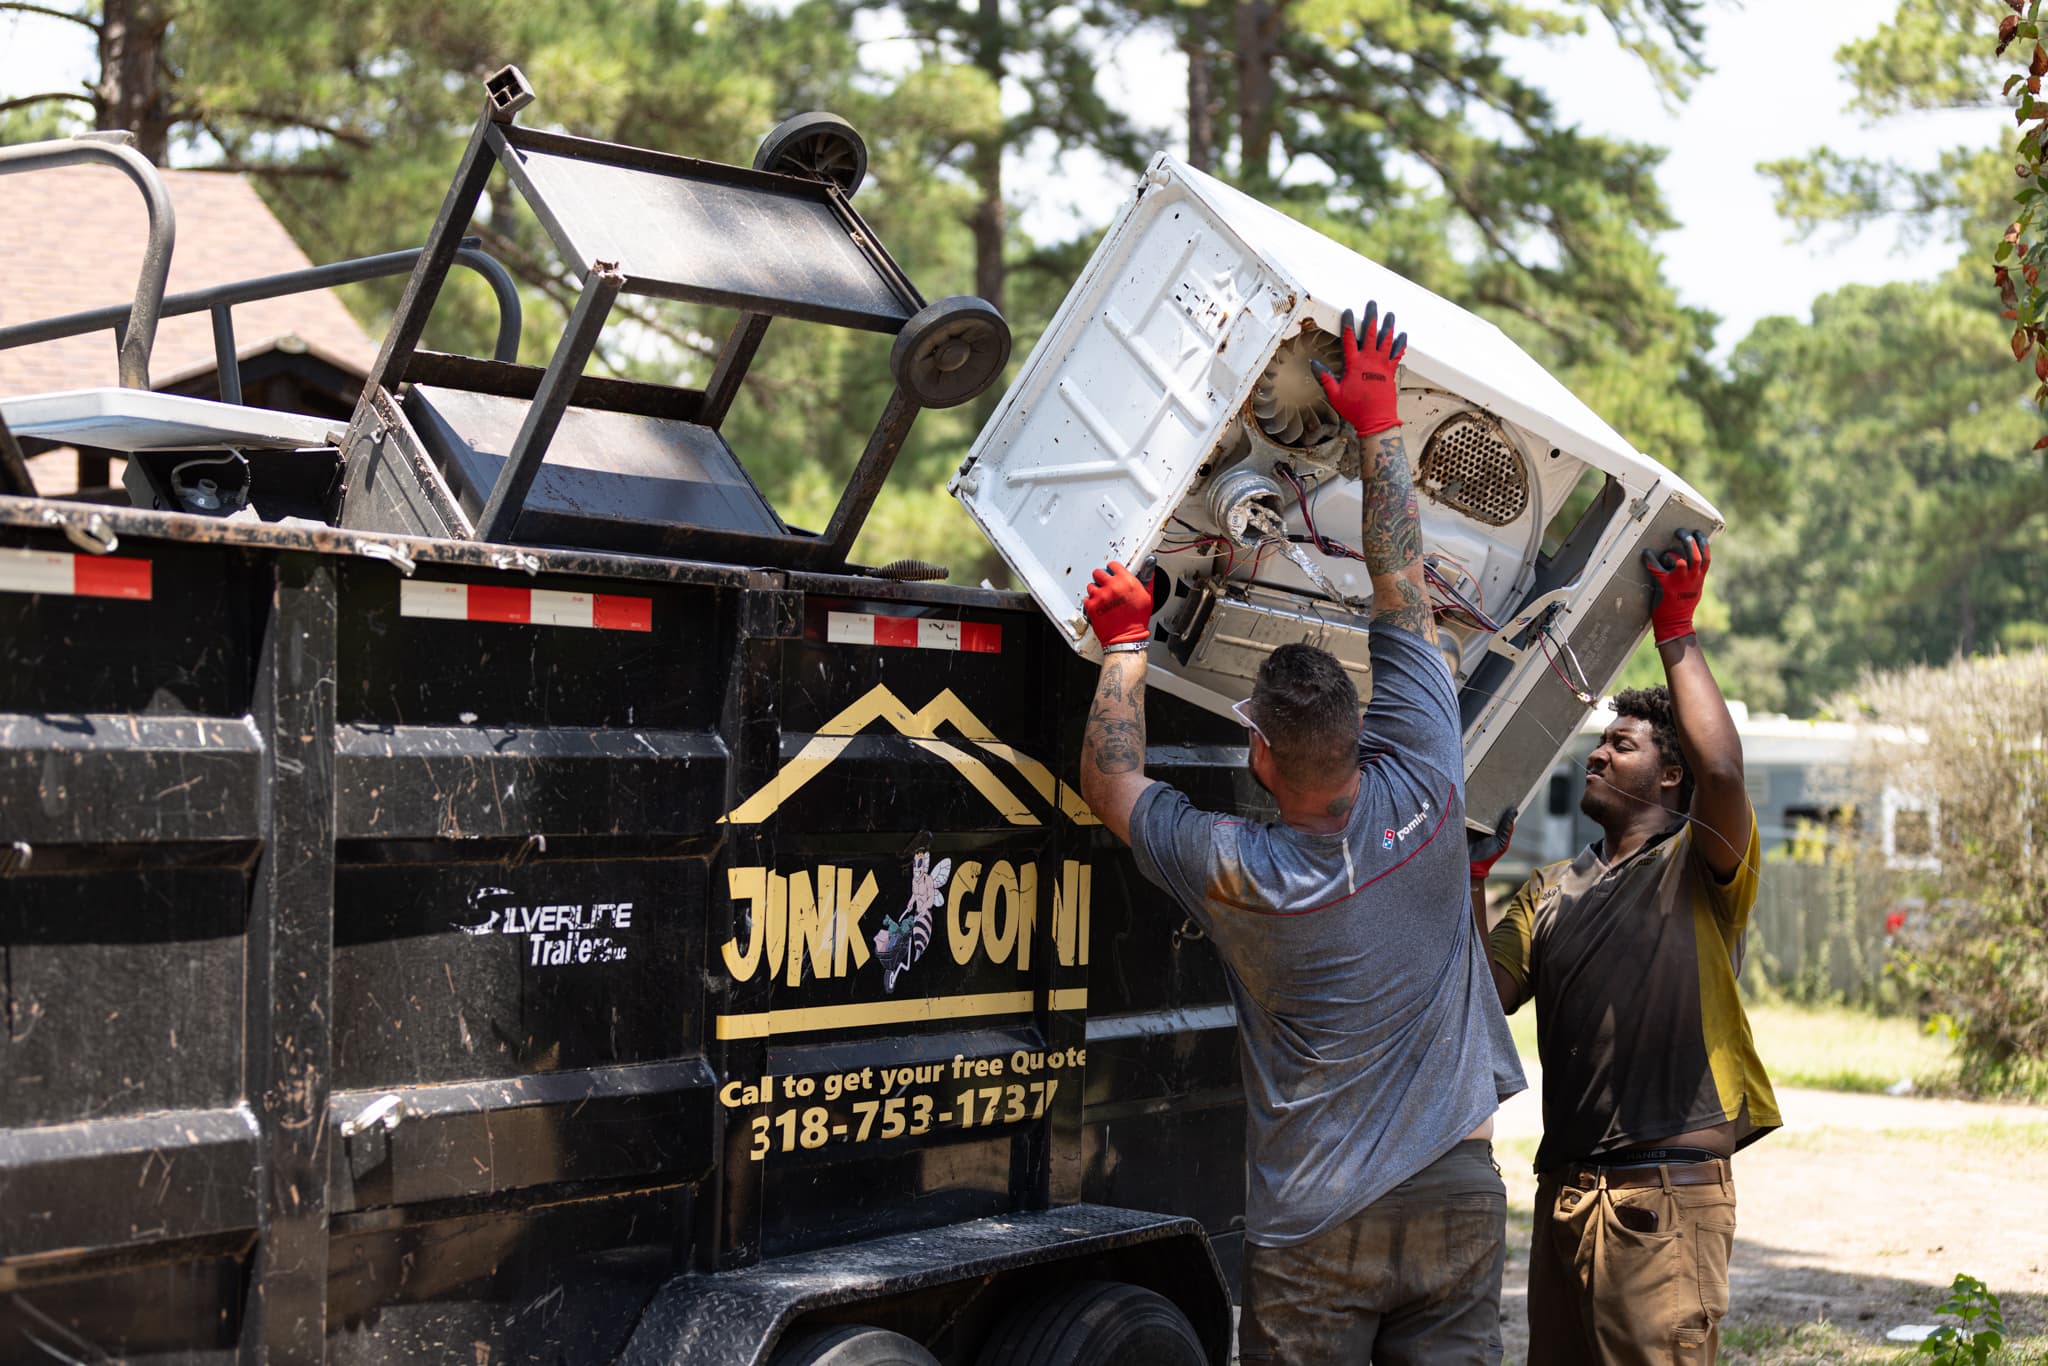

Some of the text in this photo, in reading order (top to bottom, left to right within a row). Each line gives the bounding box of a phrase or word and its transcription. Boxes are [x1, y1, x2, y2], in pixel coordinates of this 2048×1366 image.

[1396, 801, 1430, 841] Domins
[719, 1046, 1087, 1108] Call to get your free Quote
[750, 1079, 1059, 1161] 318-753-1737
